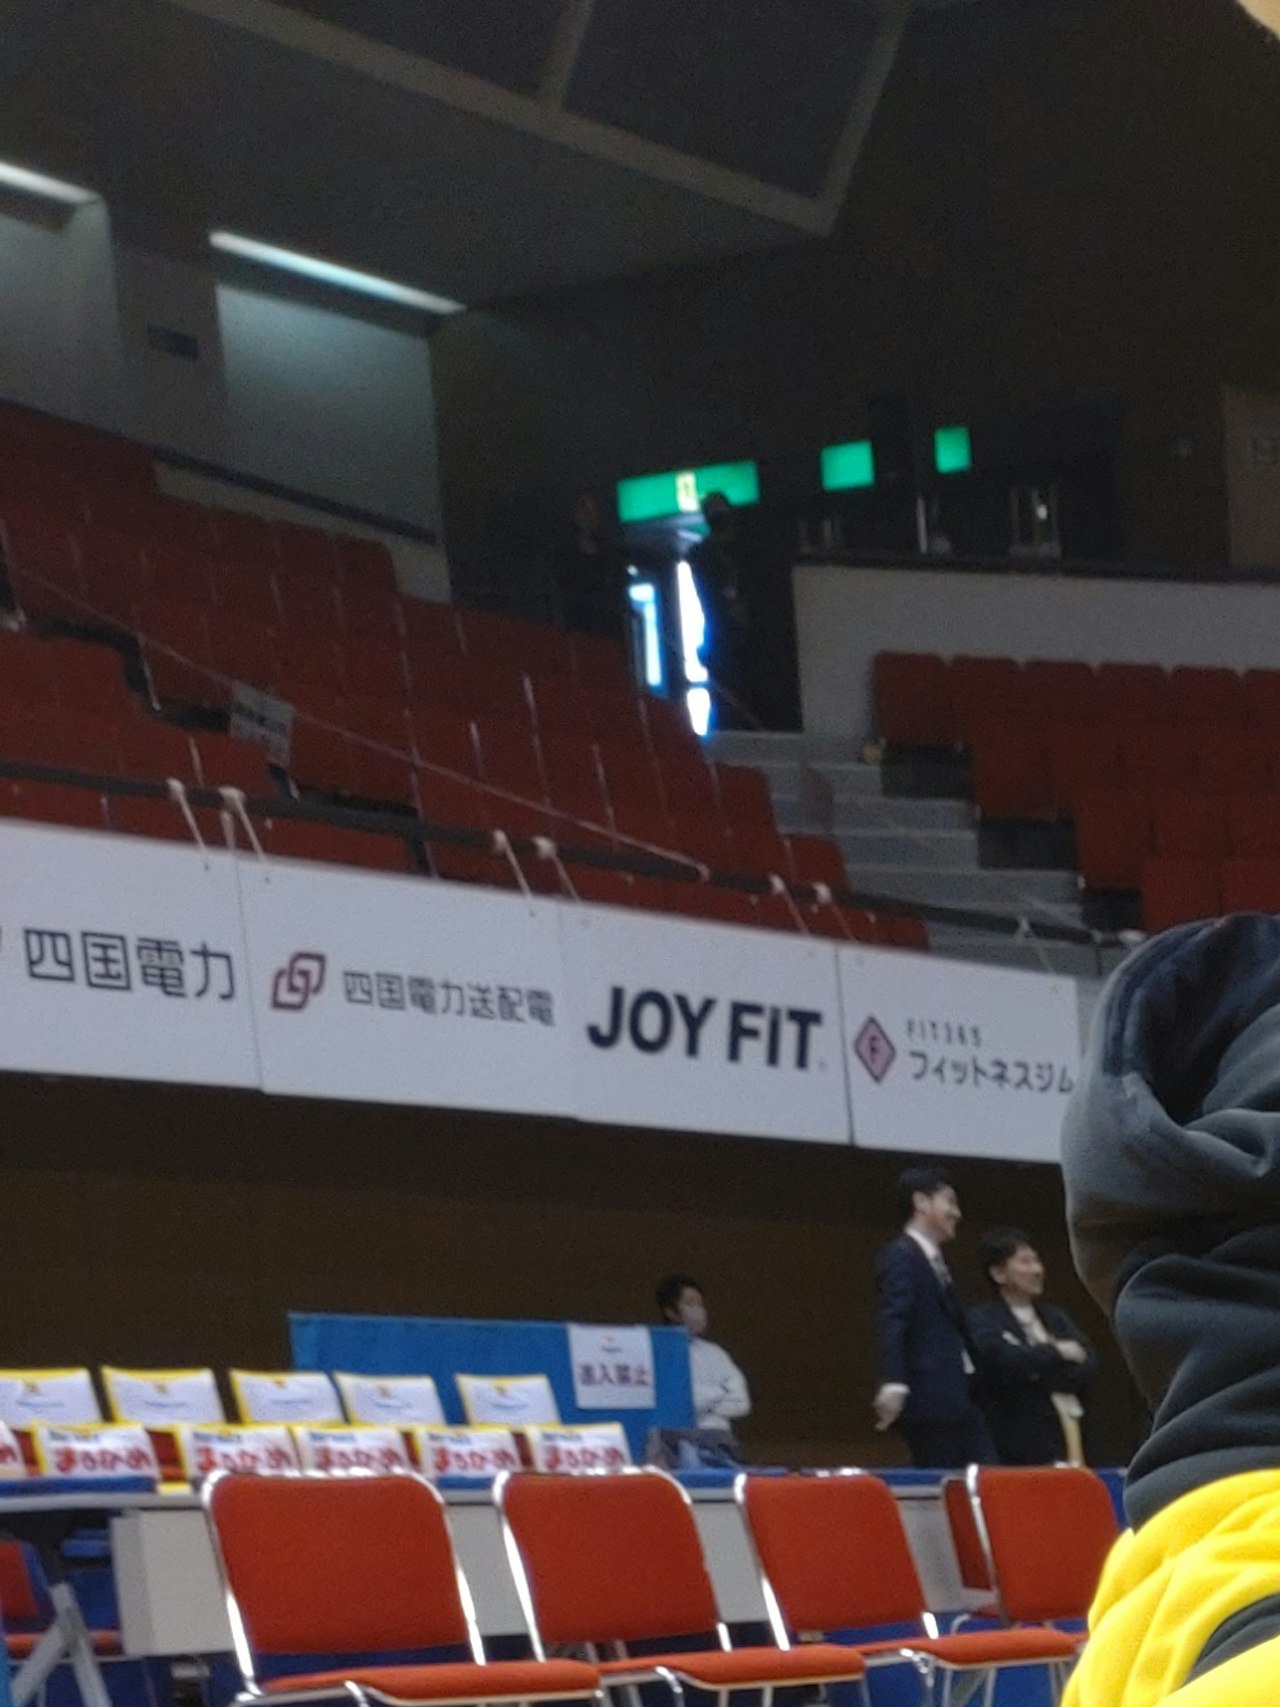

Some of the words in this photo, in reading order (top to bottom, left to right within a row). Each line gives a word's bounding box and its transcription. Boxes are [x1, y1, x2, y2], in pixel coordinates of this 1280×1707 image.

[24, 928, 236, 1001] 四国電力
[341, 970, 556, 1027] 四国電力送配電
